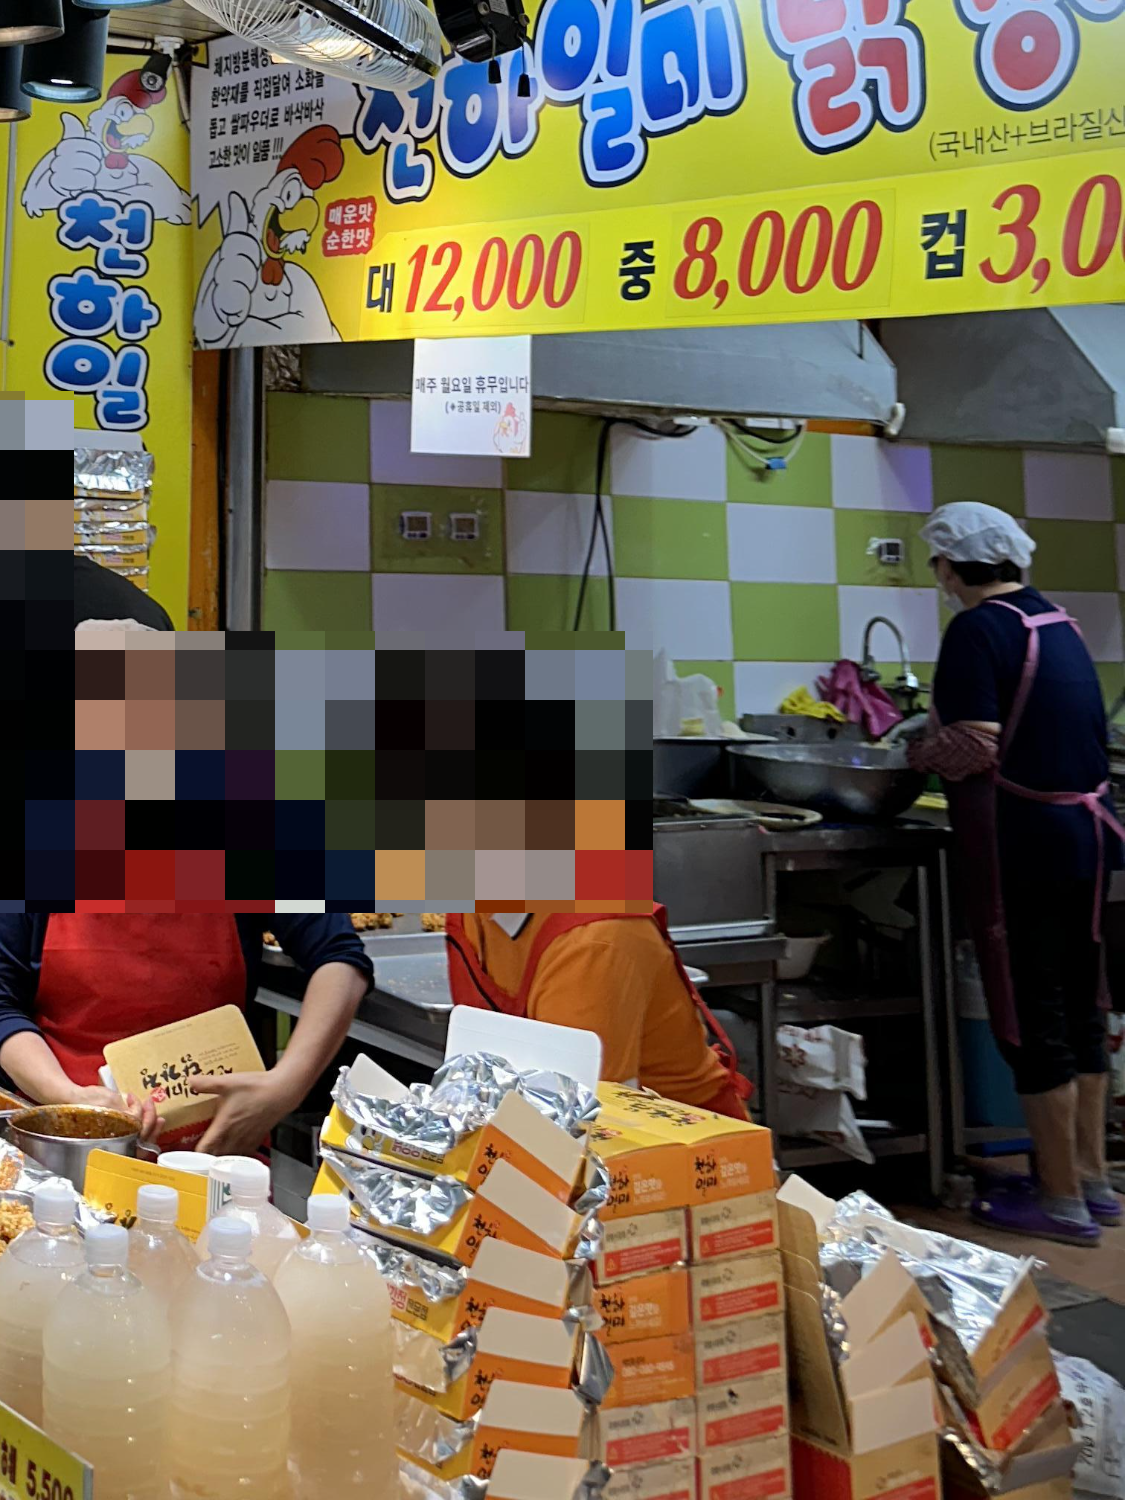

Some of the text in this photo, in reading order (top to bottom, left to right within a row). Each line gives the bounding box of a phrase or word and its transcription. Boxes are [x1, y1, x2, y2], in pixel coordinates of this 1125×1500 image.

[211, 82, 249, 108] 한약재를
[209, 97, 325, 139] 돕고 쌀파우더로 바삭바삭
[208, 145, 231, 169] 고소한
[233, 142, 250, 166] 맛이
[328, 202, 373, 226] 매운맛
[325, 228, 371, 250] 순한맛
[366, 174, 1125, 323] 대 12,000 중 8,000 컵 3,0
[416, 376, 529, 394] 매주 월요일 휴무입니다
